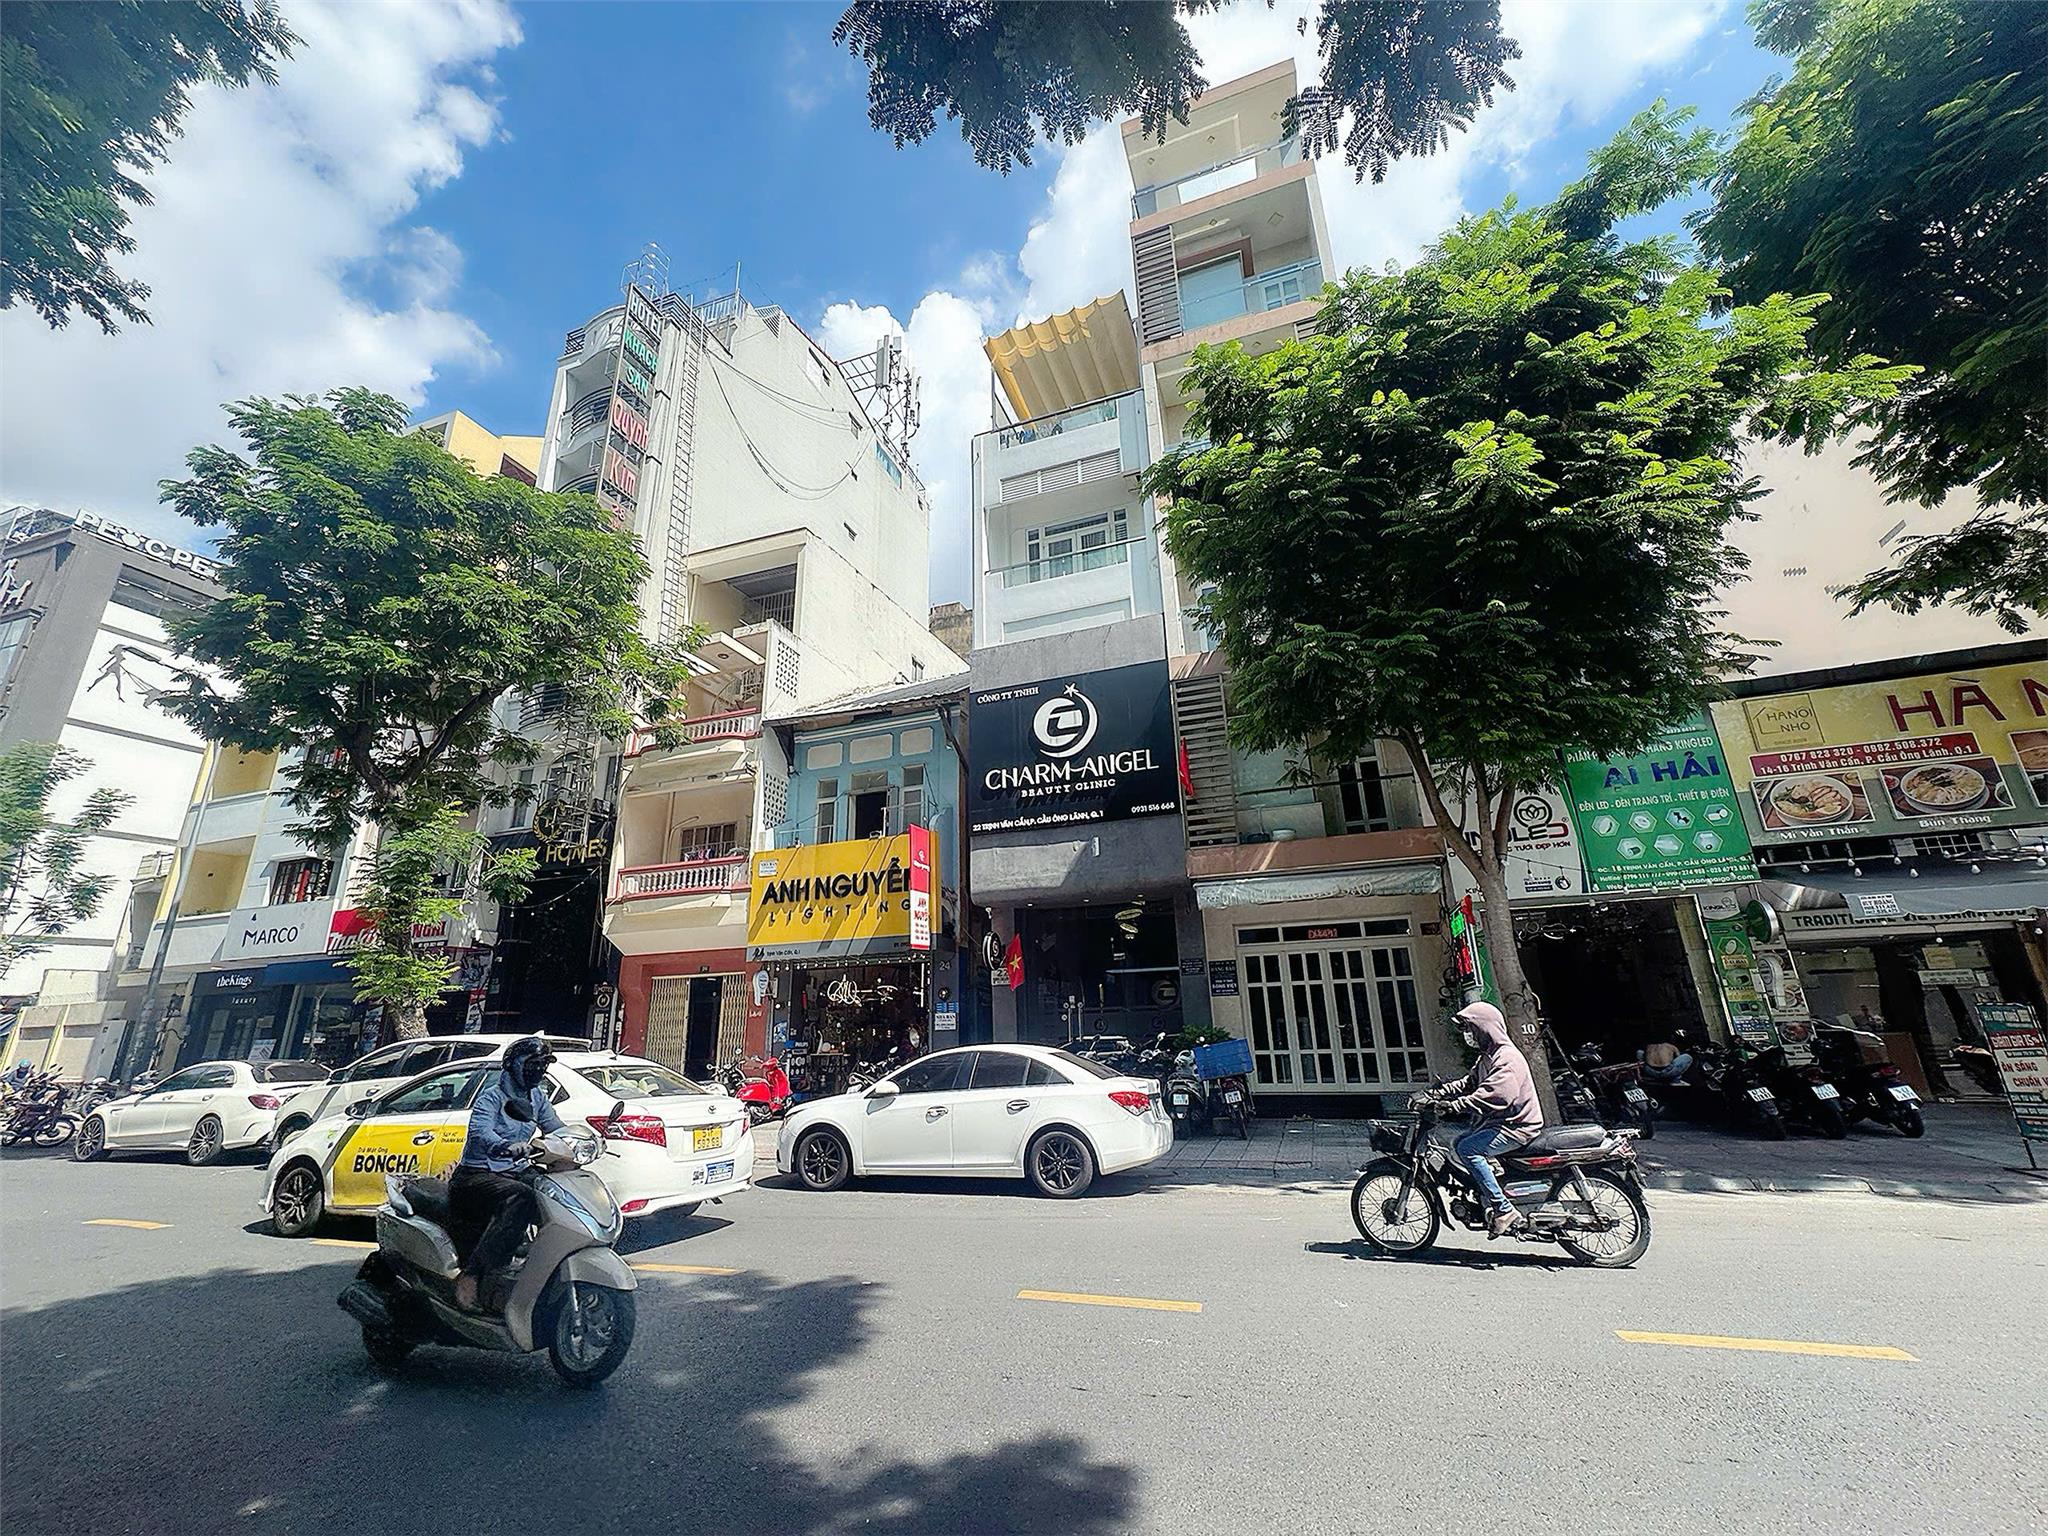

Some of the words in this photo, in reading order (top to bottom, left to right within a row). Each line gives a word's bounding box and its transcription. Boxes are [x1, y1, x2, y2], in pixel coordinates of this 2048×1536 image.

[631, 294, 661, 335] HOTEL
[608, 451, 636, 497] Kim
[977, 692, 1000, 704] CÔNG
[1001, 690, 1012, 700] TY
[1013, 687, 1039, 698] TNHH
[1886, 676, 2007, 732] HÀ
[1674, 736, 1713, 750] KINGLED
[1760, 765, 1790, 775] 14-16
[1866, 756, 1877, 765] P.
[1955, 745, 1973, 756] Q.1
[1780, 752, 1807, 762] 0767
[1834, 748, 1854, 758] 320
[1650, 751, 1722, 782] HẢI
[1021, 784, 1070, 798] BEAUTY
[1075, 779, 1116, 791] CLINIC
[1131, 805, 1148, 814] 0931
[1148, 804, 1160, 812] 516
[1161, 802, 1175, 810] 668
[1596, 801, 1609, 810] LED
[1632, 795, 1658, 806] TRANG
[762, 876, 810, 905] ANH
[770, 900, 911, 923] LIGHTING
[242, 926, 298, 947] MARCO
[939, 961, 950, 971] 24
[1521, 1024, 1536, 1035] 10
[353, 1155, 419, 1173] BONCHA
